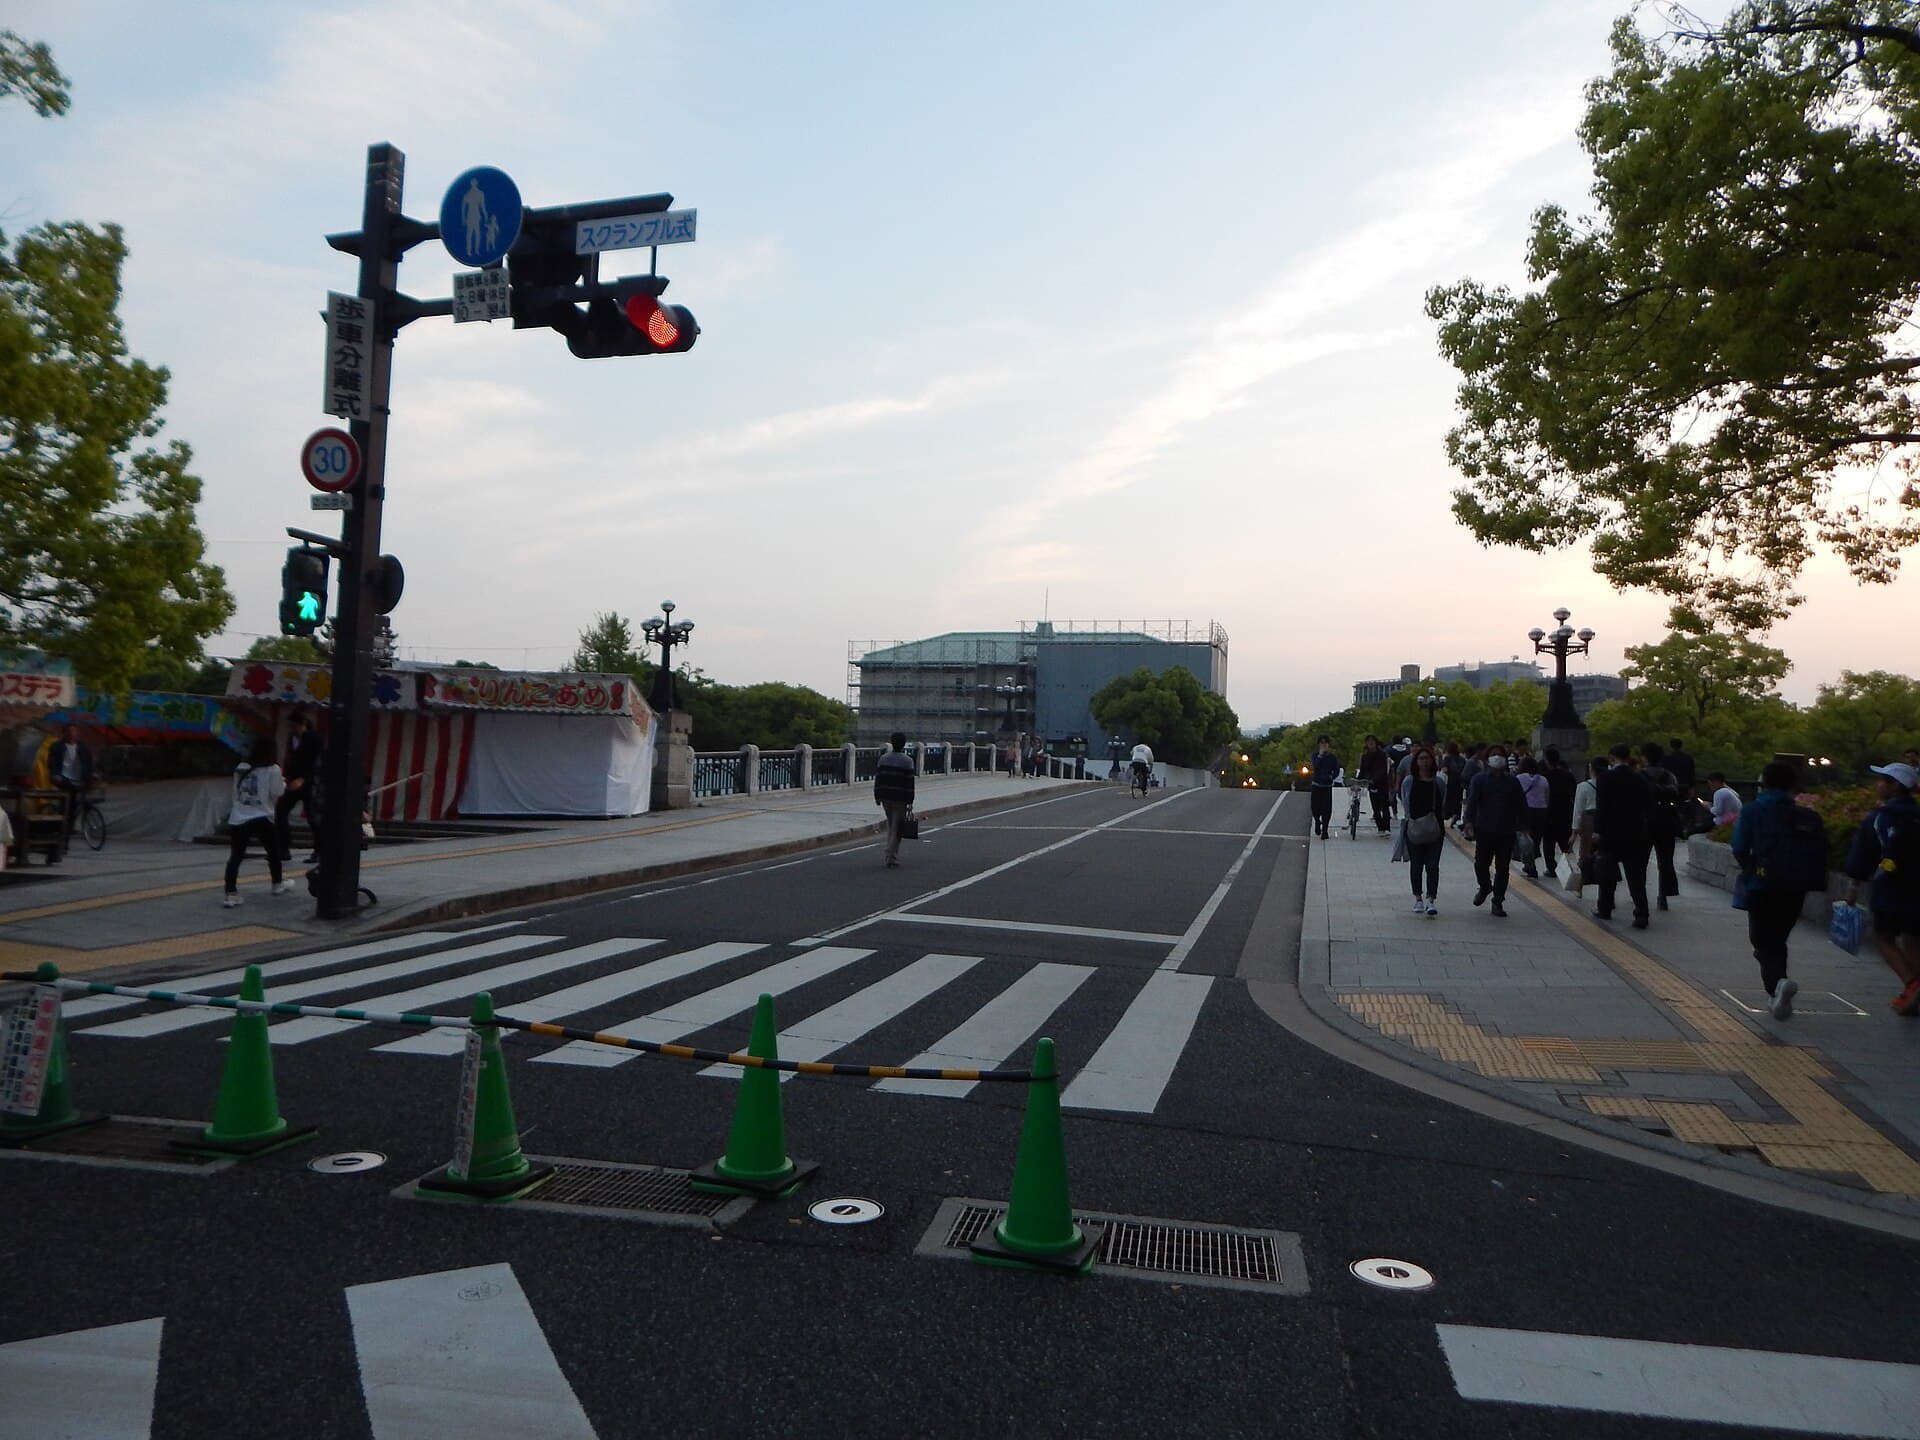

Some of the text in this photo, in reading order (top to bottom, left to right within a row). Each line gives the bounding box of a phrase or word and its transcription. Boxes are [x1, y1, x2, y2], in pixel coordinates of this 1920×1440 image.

[581, 215, 693, 248] スクランブル式
[333, 298, 365, 416] 歩車分離式
[314, 445, 347, 474] 30
